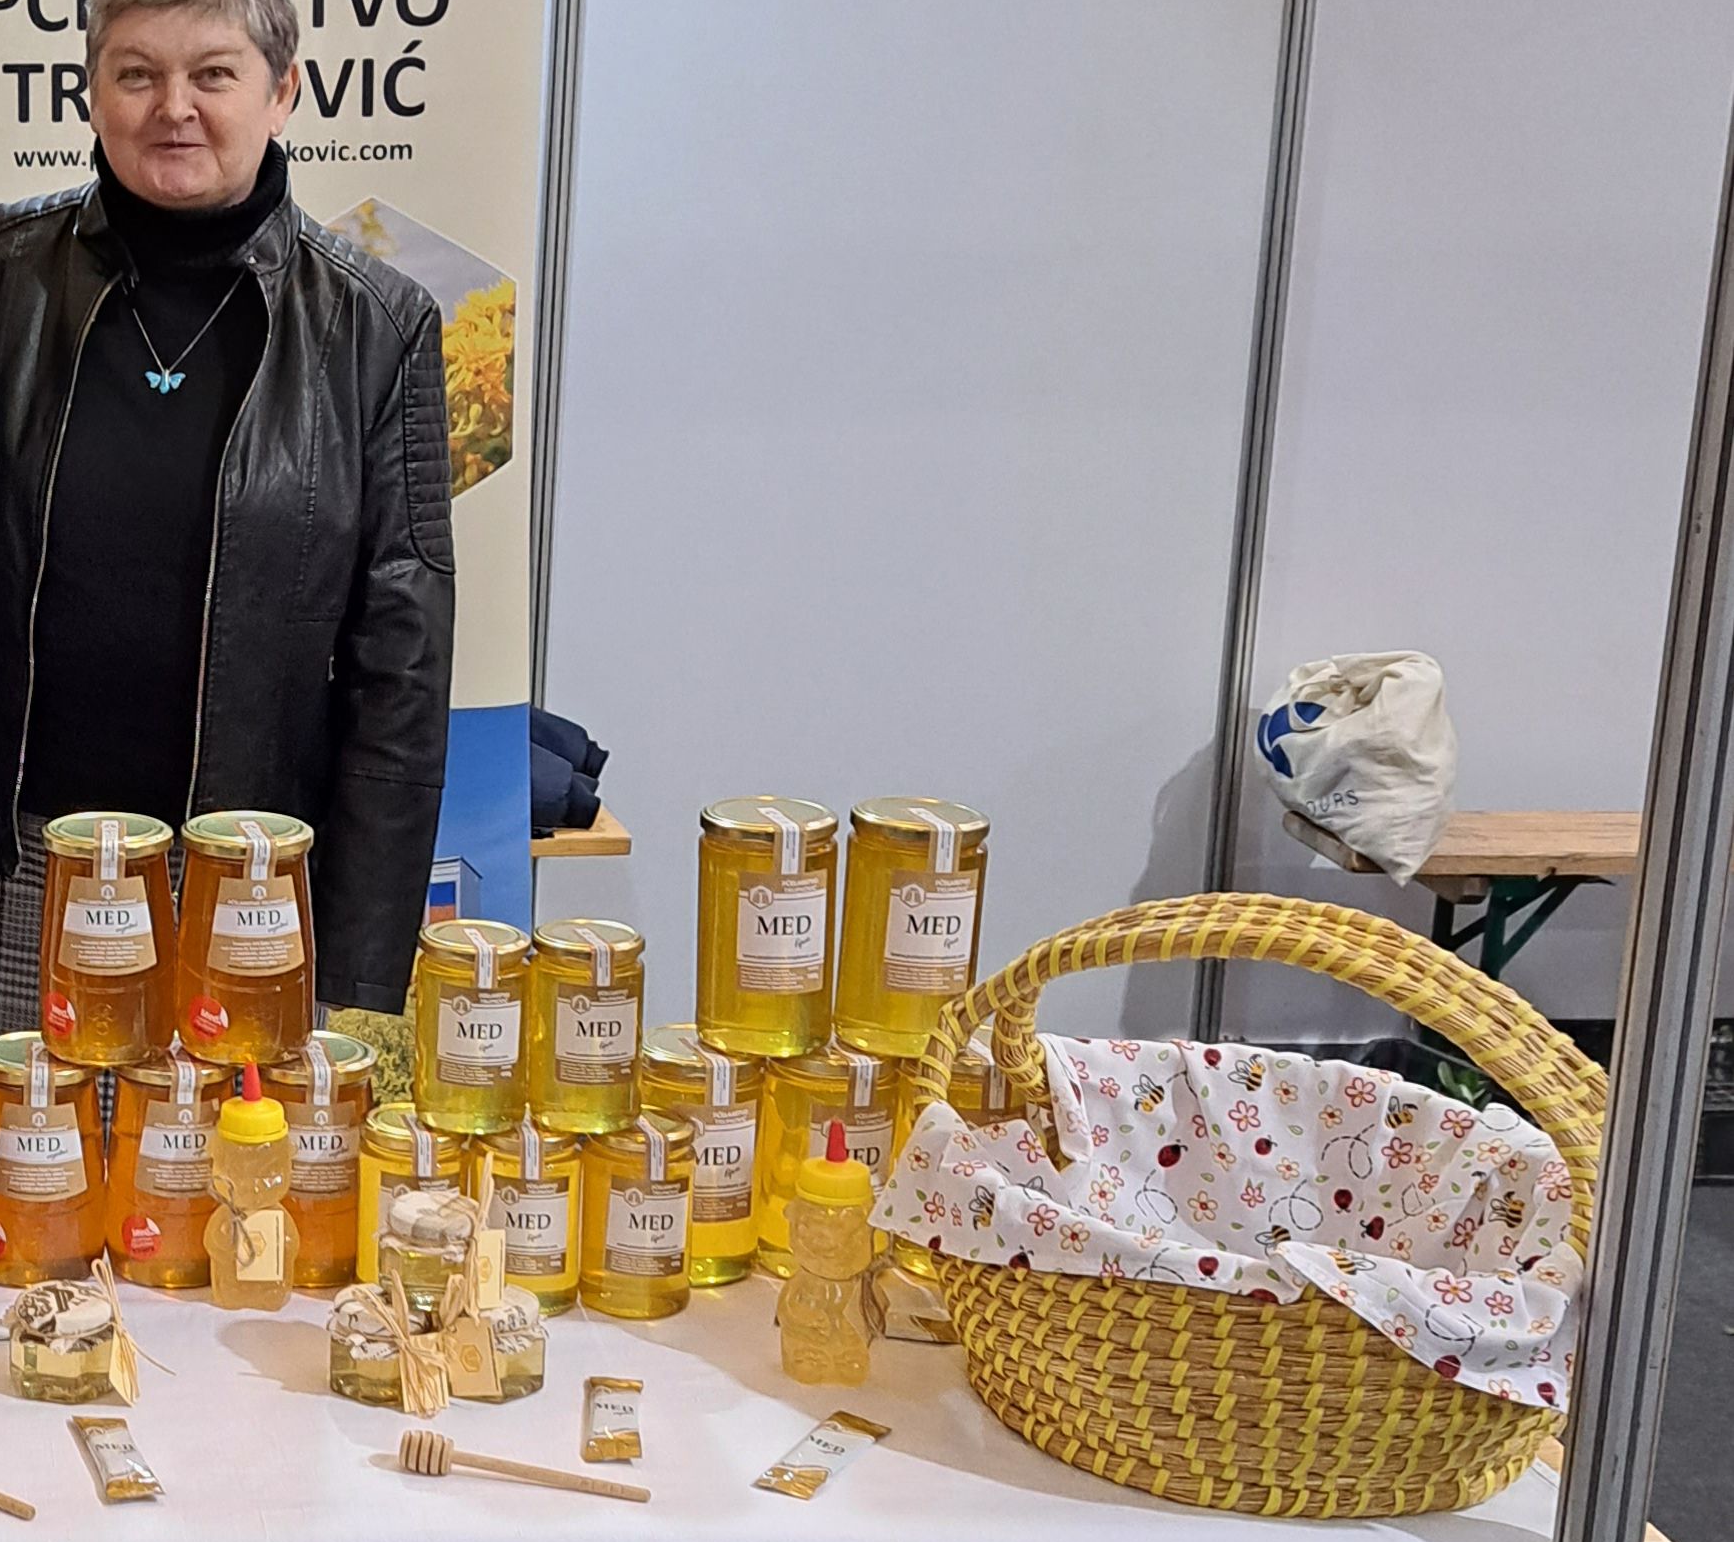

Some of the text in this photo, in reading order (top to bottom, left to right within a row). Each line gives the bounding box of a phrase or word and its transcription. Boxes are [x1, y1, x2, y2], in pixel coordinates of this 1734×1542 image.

[2, 39, 426, 123] TRVIĆ
[85, 910, 130, 926] MED
[237, 910, 281, 926] MED
[755, 914, 812, 936] MED
[905, 914, 962, 936] MED
[457, 1021, 503, 1040] MED
[576, 1020, 622, 1038] MED
[16, 1136, 62, 1153] MED
[162, 1133, 207, 1149] MED
[298, 1134, 343, 1150] MED
[504, 1211, 552, 1231] MED
[628, 1212, 674, 1231] MED
